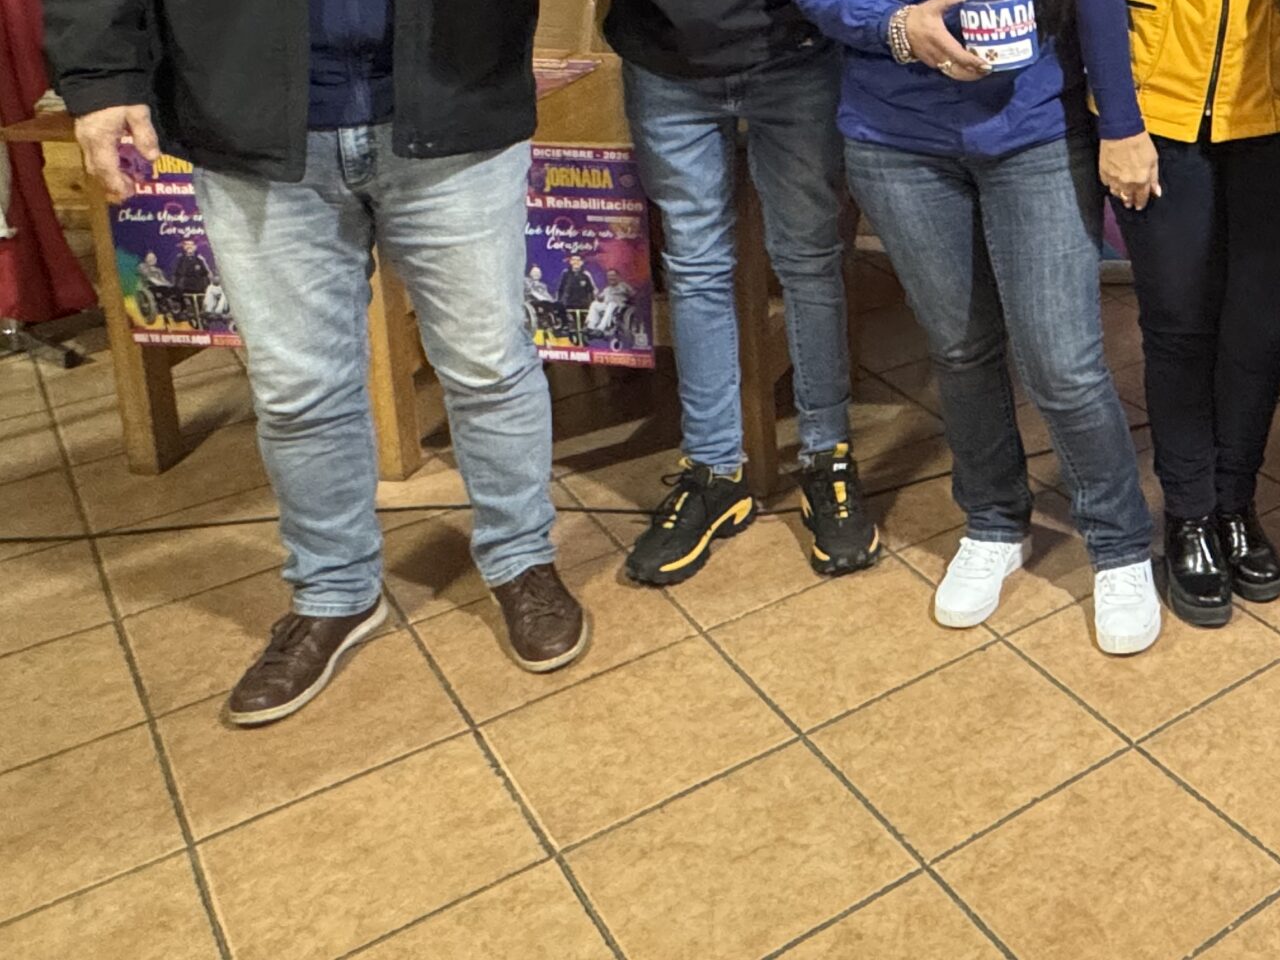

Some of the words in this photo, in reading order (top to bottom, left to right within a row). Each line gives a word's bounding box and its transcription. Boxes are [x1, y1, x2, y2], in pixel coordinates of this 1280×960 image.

[960, 0, 1037, 41] ORNADA
[532, 148, 594, 159] DICIEMBRE
[152, 152, 193, 179] JORN
[543, 163, 613, 192] JORNADA
[135, 183, 153, 194] La
[526, 196, 543, 207] La
[546, 196, 643, 211] Rehabilitación
